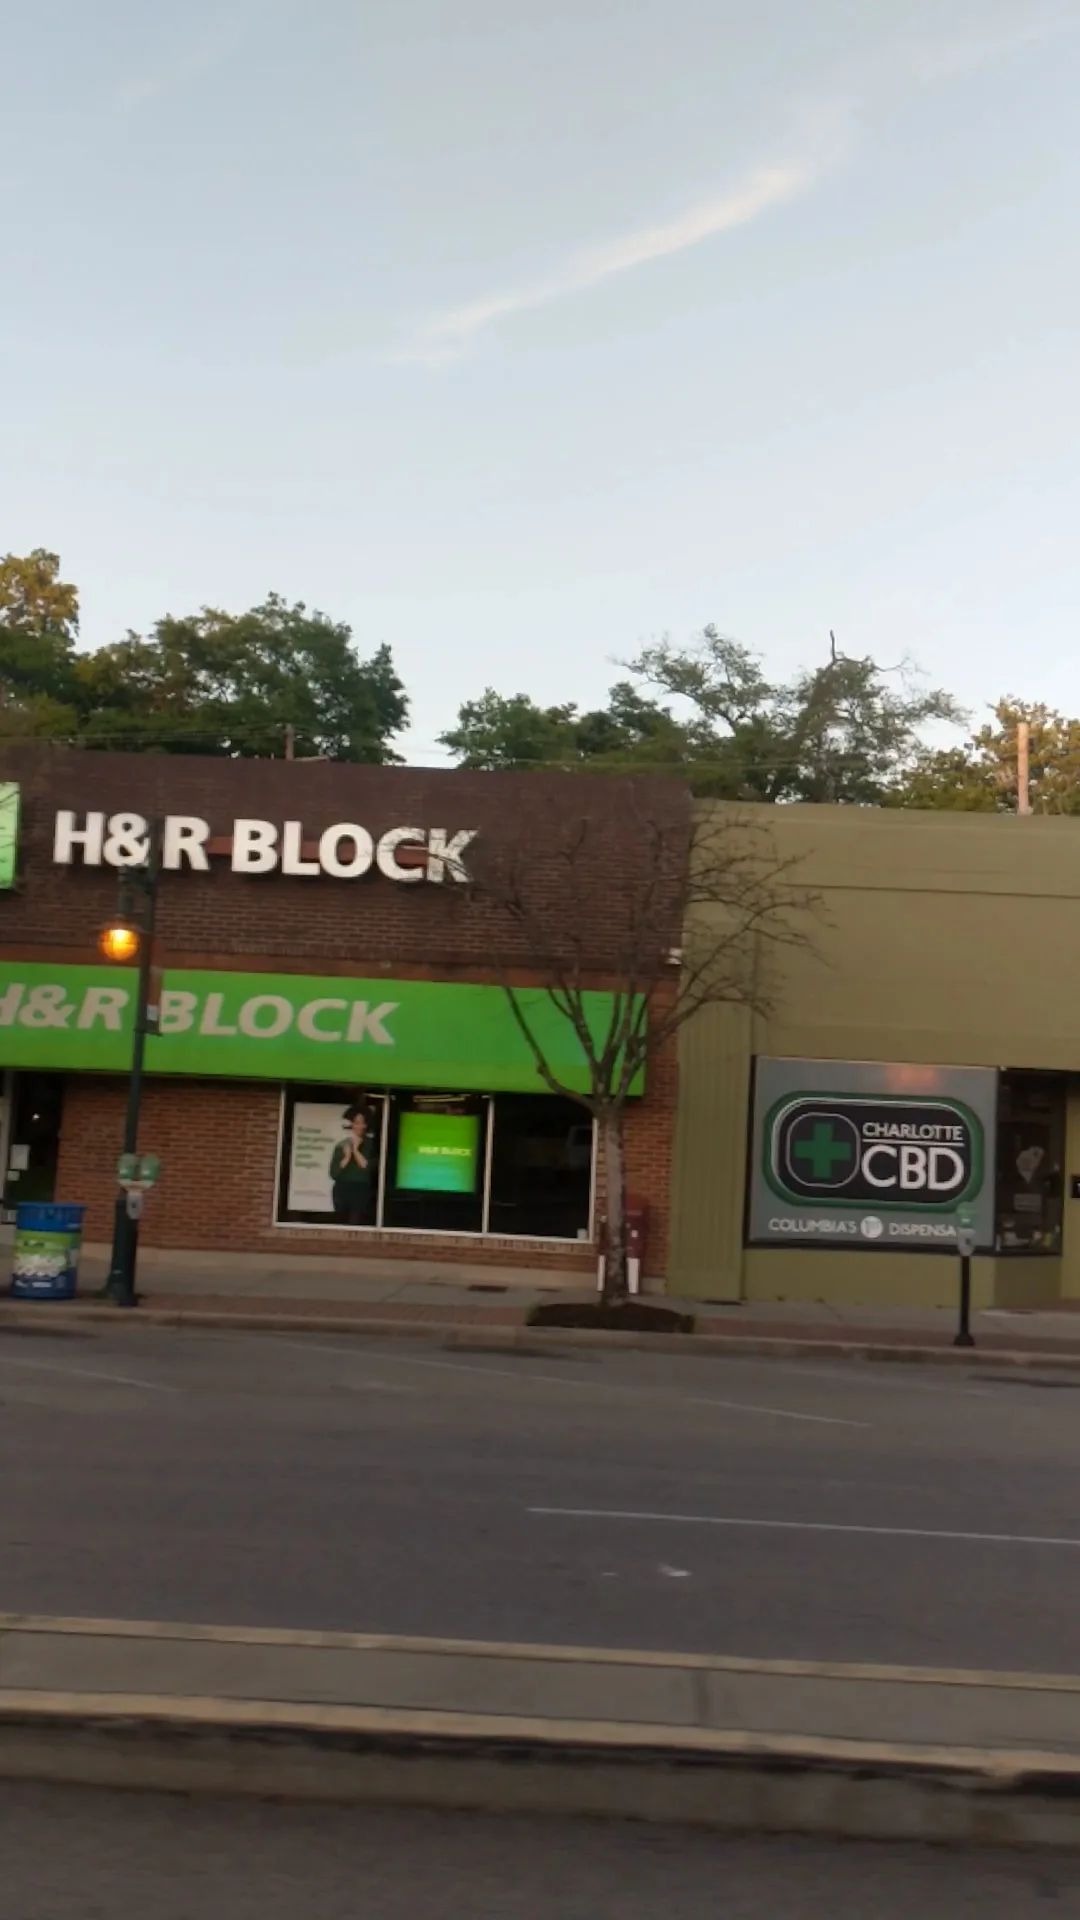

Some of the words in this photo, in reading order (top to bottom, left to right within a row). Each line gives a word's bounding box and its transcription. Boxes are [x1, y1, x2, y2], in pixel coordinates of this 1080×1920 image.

[53, 810, 211, 871] H&R
[231, 818, 478, 884] BLOCK
[160, 991, 400, 1045] BLOCK
[862, 1121, 964, 1141] CHARLOTTE
[861, 1144, 965, 1191] CBD
[888, 1222, 958, 1237] DISPENSA
